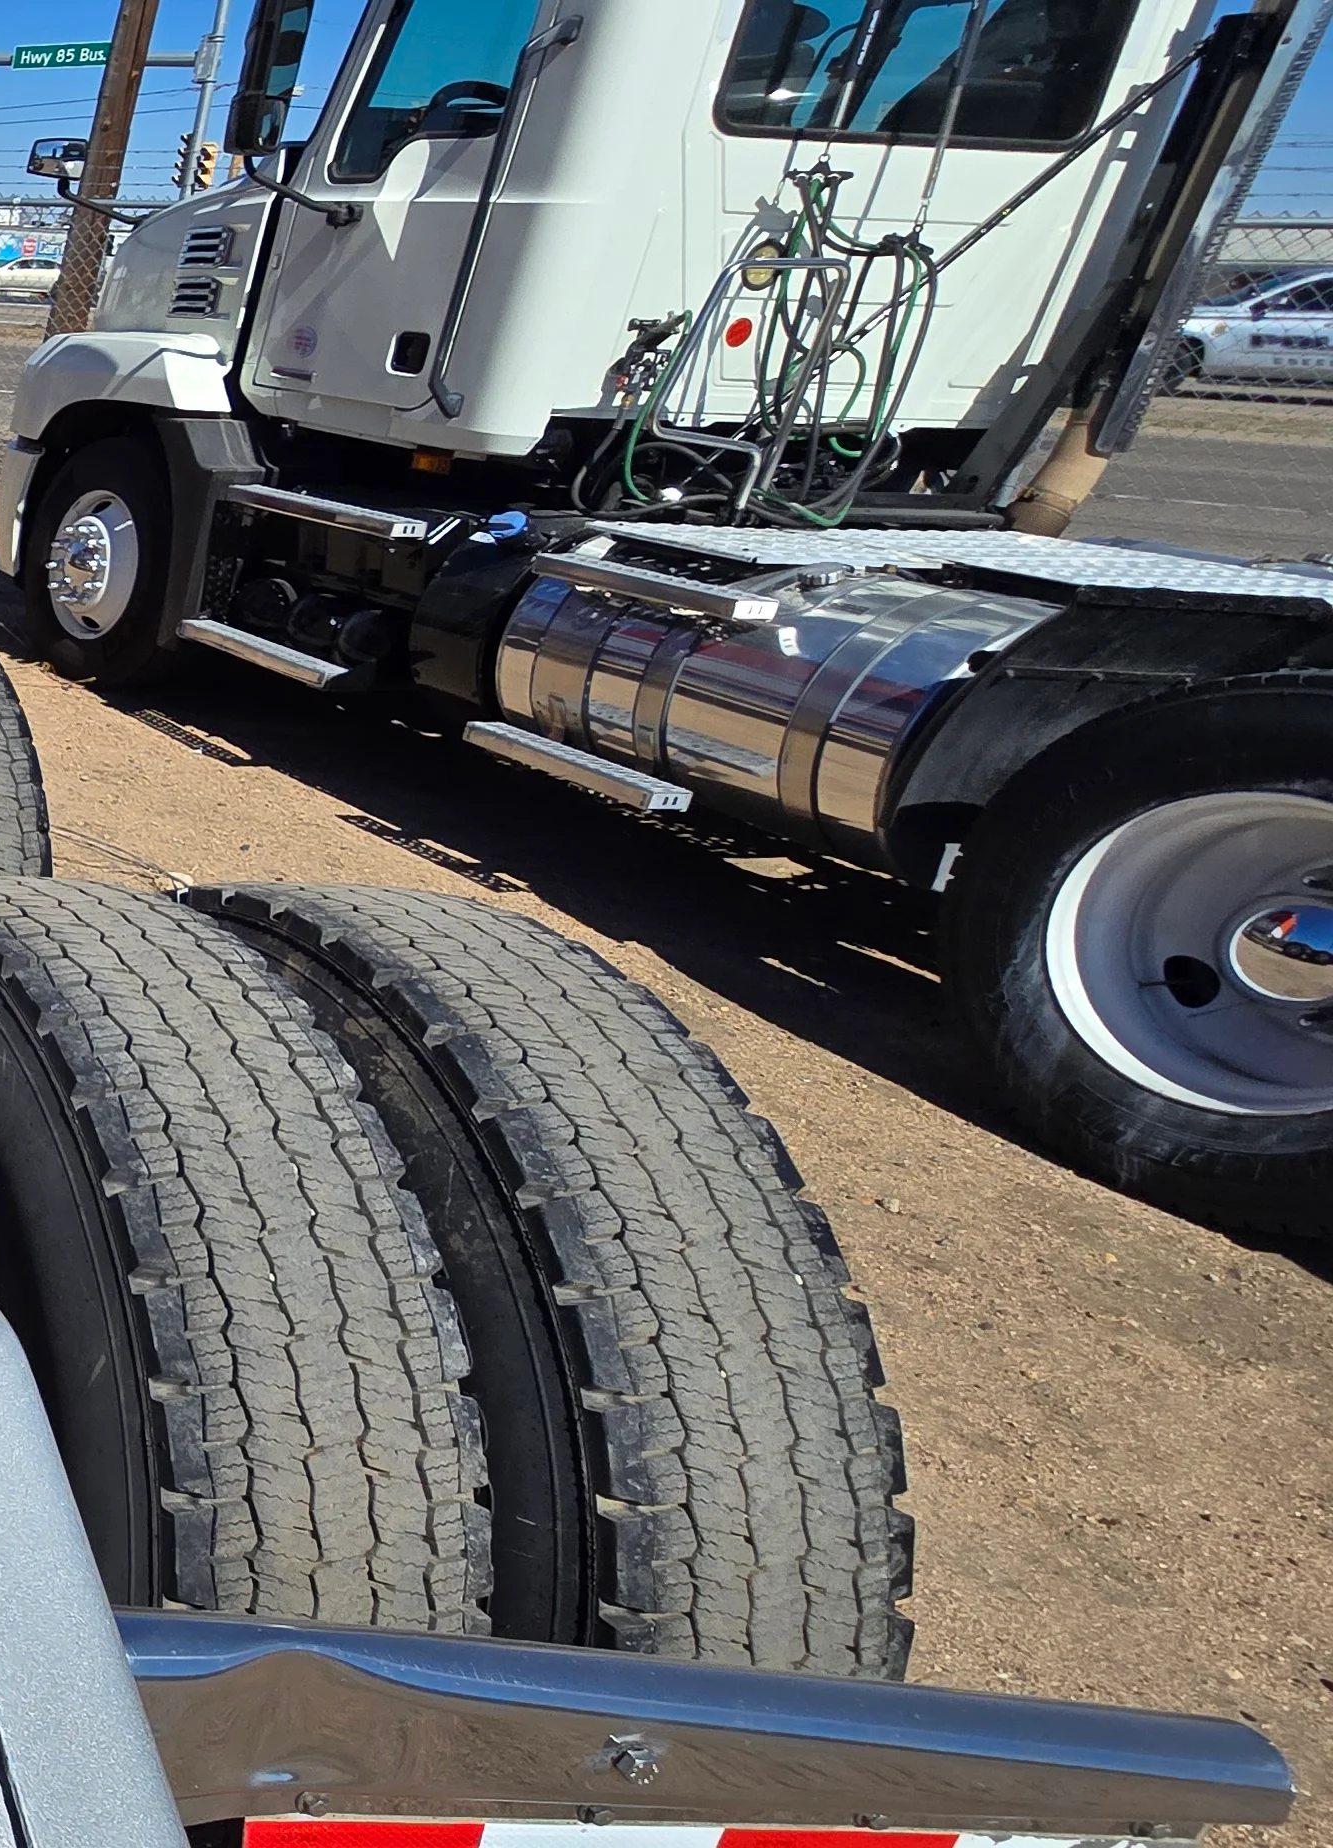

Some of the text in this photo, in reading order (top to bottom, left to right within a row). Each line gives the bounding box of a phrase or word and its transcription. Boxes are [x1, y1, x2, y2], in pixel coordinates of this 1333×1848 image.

[20, 48, 107, 66] Hwy 85 Bus.
